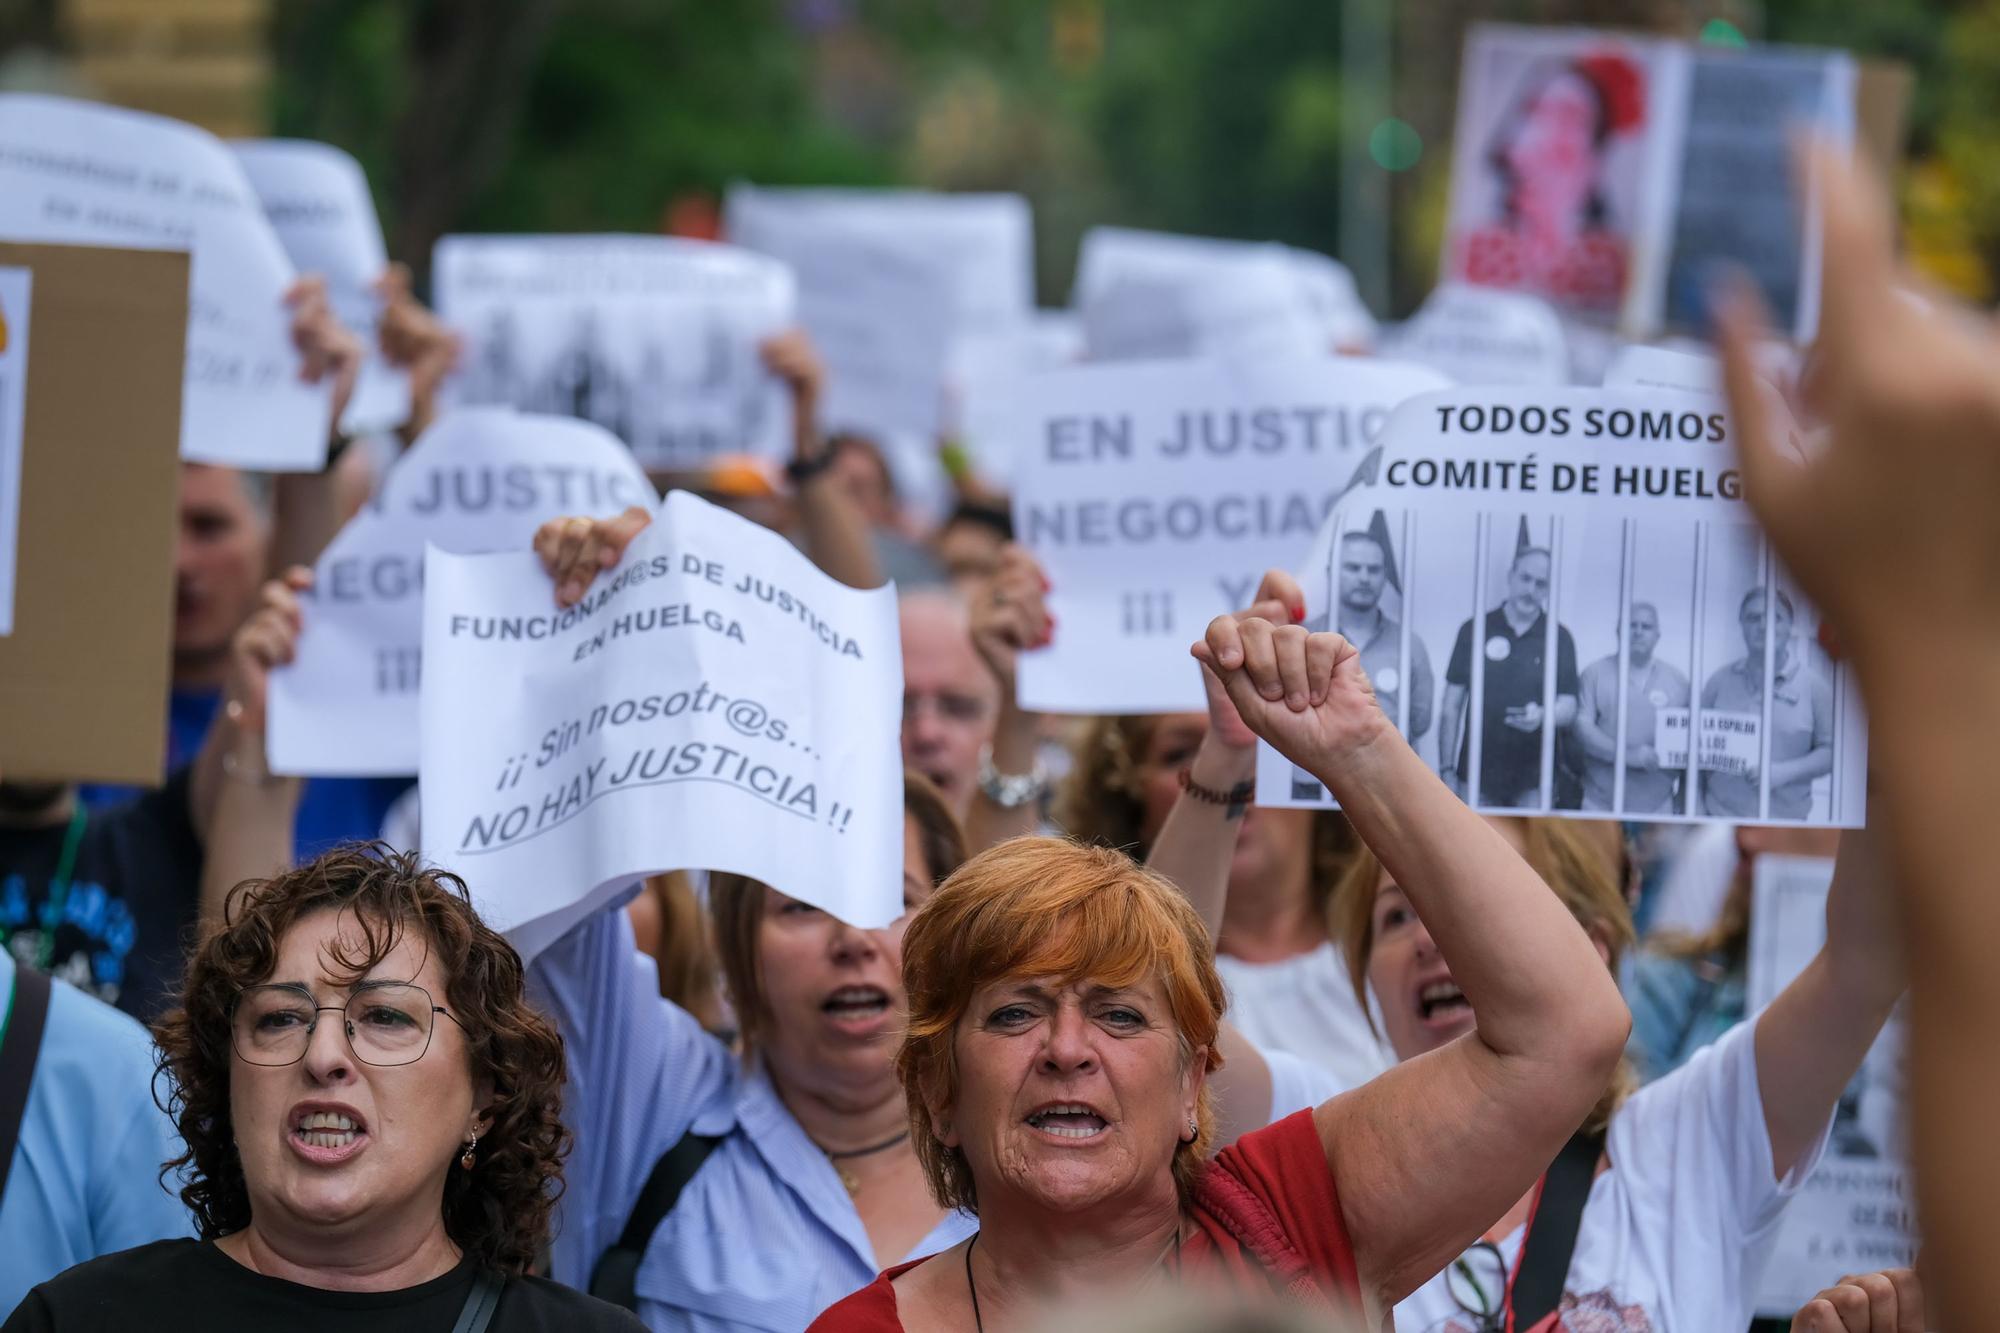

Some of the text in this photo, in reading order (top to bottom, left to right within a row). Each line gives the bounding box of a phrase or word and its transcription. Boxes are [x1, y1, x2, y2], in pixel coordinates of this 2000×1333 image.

[1045, 405, 1388, 464] EN JUSTIC
[1436, 405, 1726, 443] TODOS SOMOS
[412, 464, 634, 515] JUSTIC
[1386, 453, 1741, 501] COMITÉ DE HUELG
[1027, 491, 1340, 546] NEGOCIA
[450, 553, 864, 661] FUNCIONARI@S DE JUSTICIA
[572, 603, 747, 664] EN HUELGA
[536, 718, 582, 769] Sin
[587, 681, 822, 761] nosotr@s...
[461, 741, 854, 850] NO HAY JUSTICIA !!
